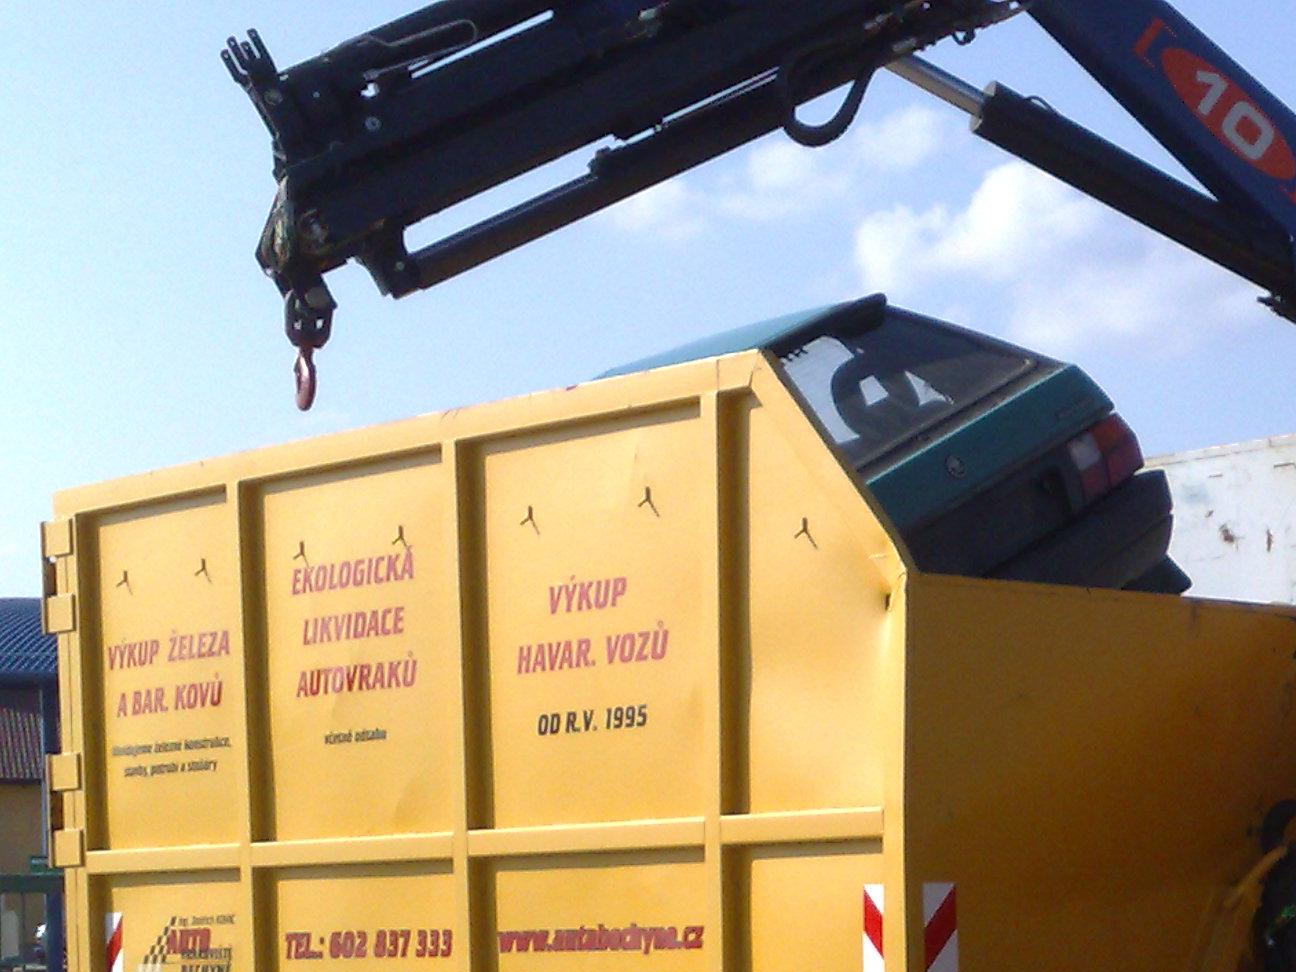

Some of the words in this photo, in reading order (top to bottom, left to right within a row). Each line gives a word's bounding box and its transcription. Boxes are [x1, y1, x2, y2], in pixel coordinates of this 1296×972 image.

[1196, 70, 1273, 160] 10
[292, 545, 414, 596] EKOLOGICKÁ
[549, 574, 628, 615] VÝKUP
[303, 606, 405, 646] LIKVIDACE
[517, 638, 596, 675] HAVAR.
[605, 620, 669, 665] VOZŮ
[108, 637, 160, 671] VÝKUP
[167, 629, 230, 662] ŽELEZA
[117, 692, 127, 717] A
[132, 687, 168, 715] BAR.
[174, 672, 223, 711] KOVŮ
[296, 650, 417, 698] AUTOVRAKŮ
[538, 712, 560, 736] OD
[606, 703, 647, 730] 1995
[330, 931, 367, 959] 602
[374, 929, 411, 958] 837
[416, 929, 453, 957] 333
